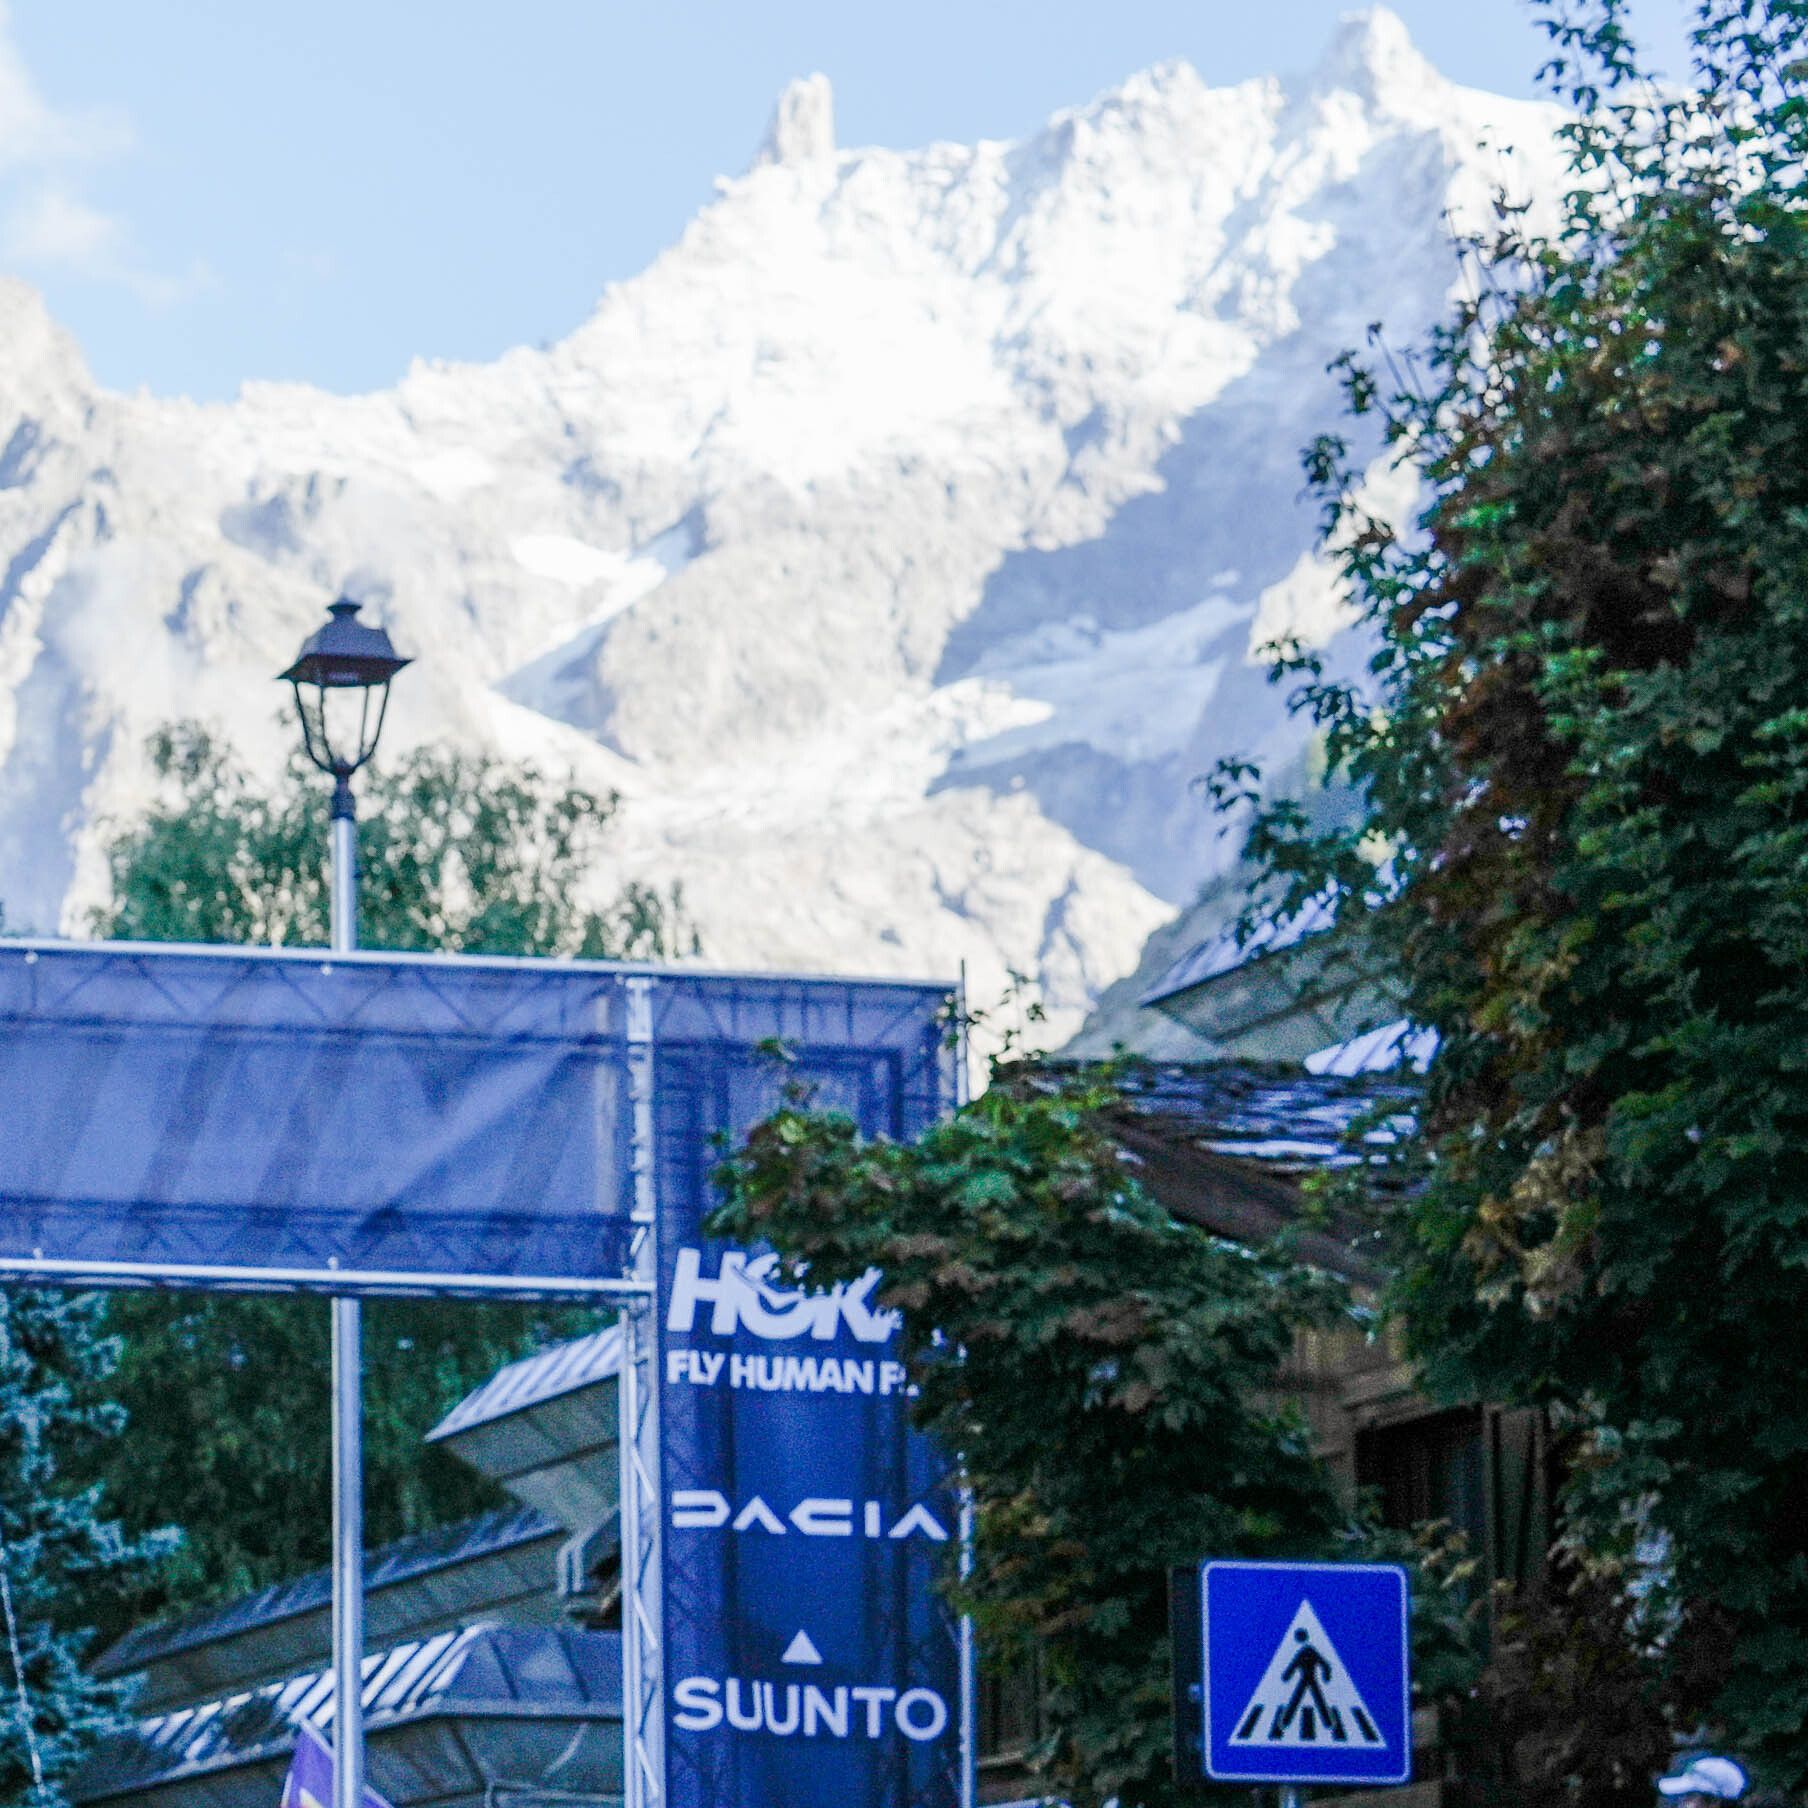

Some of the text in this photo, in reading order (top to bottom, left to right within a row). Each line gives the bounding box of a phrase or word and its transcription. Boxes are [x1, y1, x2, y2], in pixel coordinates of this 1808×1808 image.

[666, 1247, 902, 1343] HOK
[667, 1348, 725, 1387] FLY
[730, 1353, 874, 1394] HUMAN
[671, 1489, 950, 1541] DACIA
[673, 1675, 948, 1741] SUUNTO
